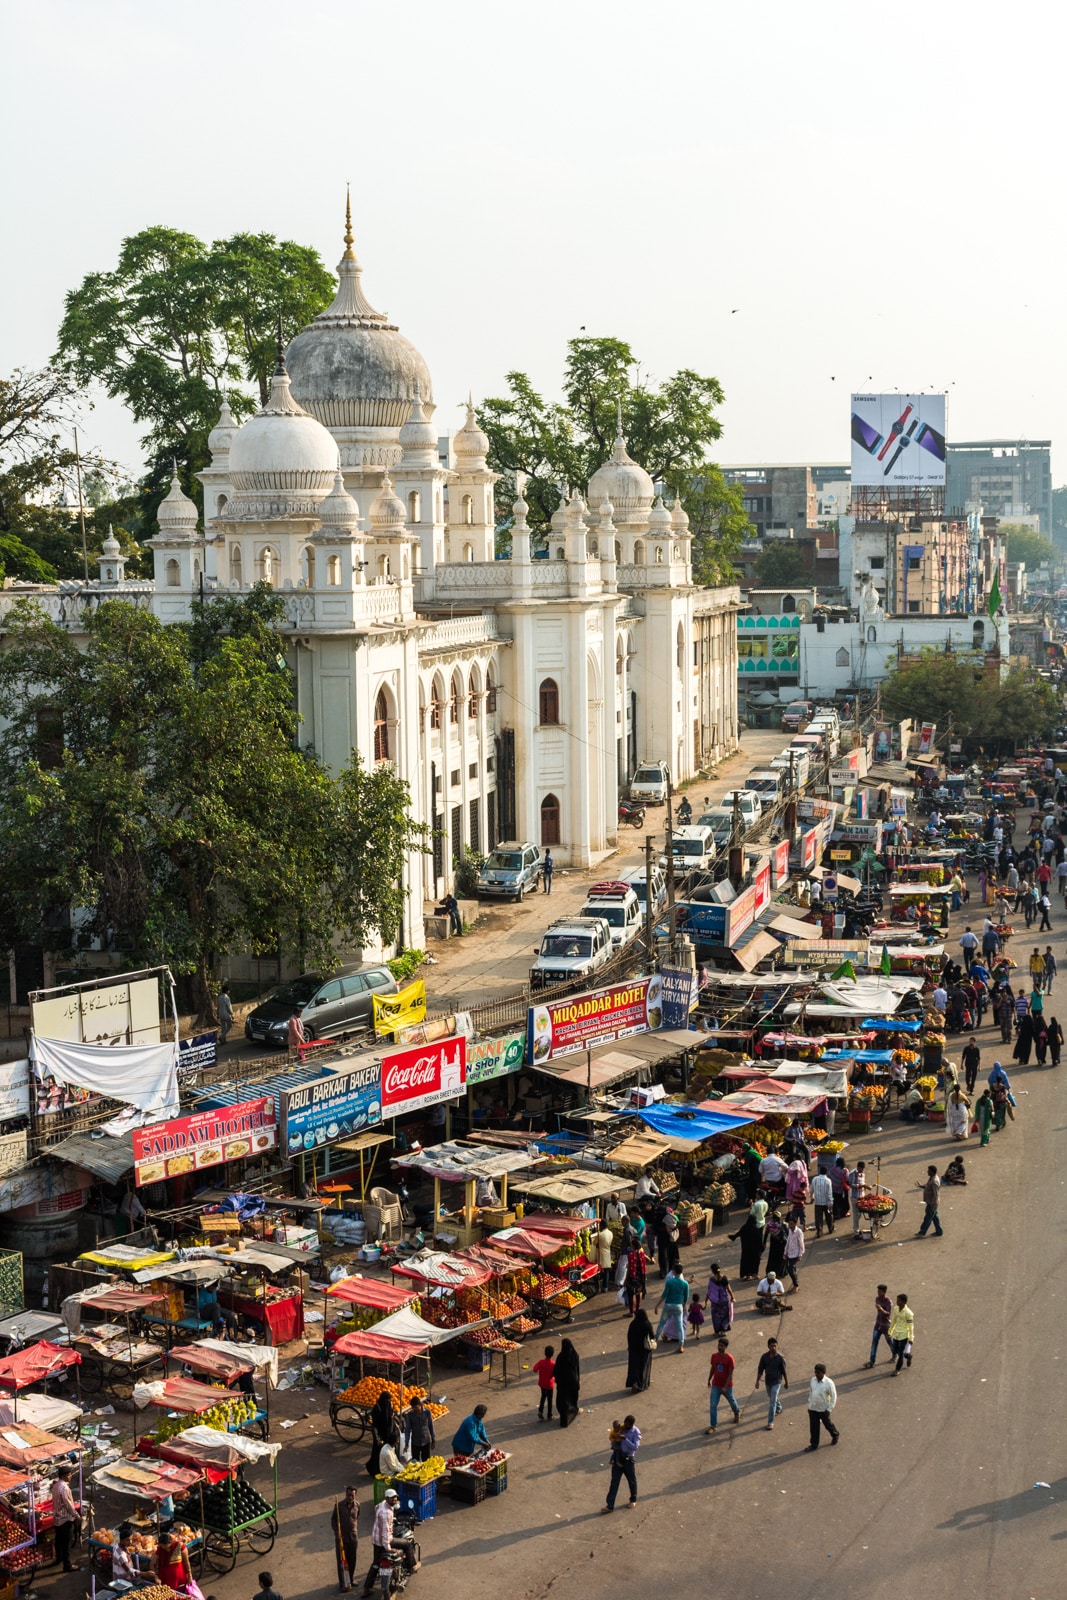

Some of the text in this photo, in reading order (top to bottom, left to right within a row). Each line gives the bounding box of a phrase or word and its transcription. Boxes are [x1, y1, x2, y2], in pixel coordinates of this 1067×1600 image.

[662, 976, 690, 992] KALYANI
[410, 997, 423, 1007] 4G
[553, 986, 645, 1024] MUQADDAR HOTEL
[601, 1010, 623, 1022] CHICKEN
[475, 1056, 500, 1070] SHOP
[385, 1054, 438, 1093] Coca-Cola
[288, 1089, 310, 1111] ABUL
[312, 1076, 348, 1103] BARKAAT
[349, 1065, 381, 1090] BAKERY
[440, 1090, 451, 1098] SWEET
[452, 1086, 464, 1094] HOUSE
[142, 1124, 210, 1158] SADDAM
[214, 1110, 268, 1138] HOTEL
